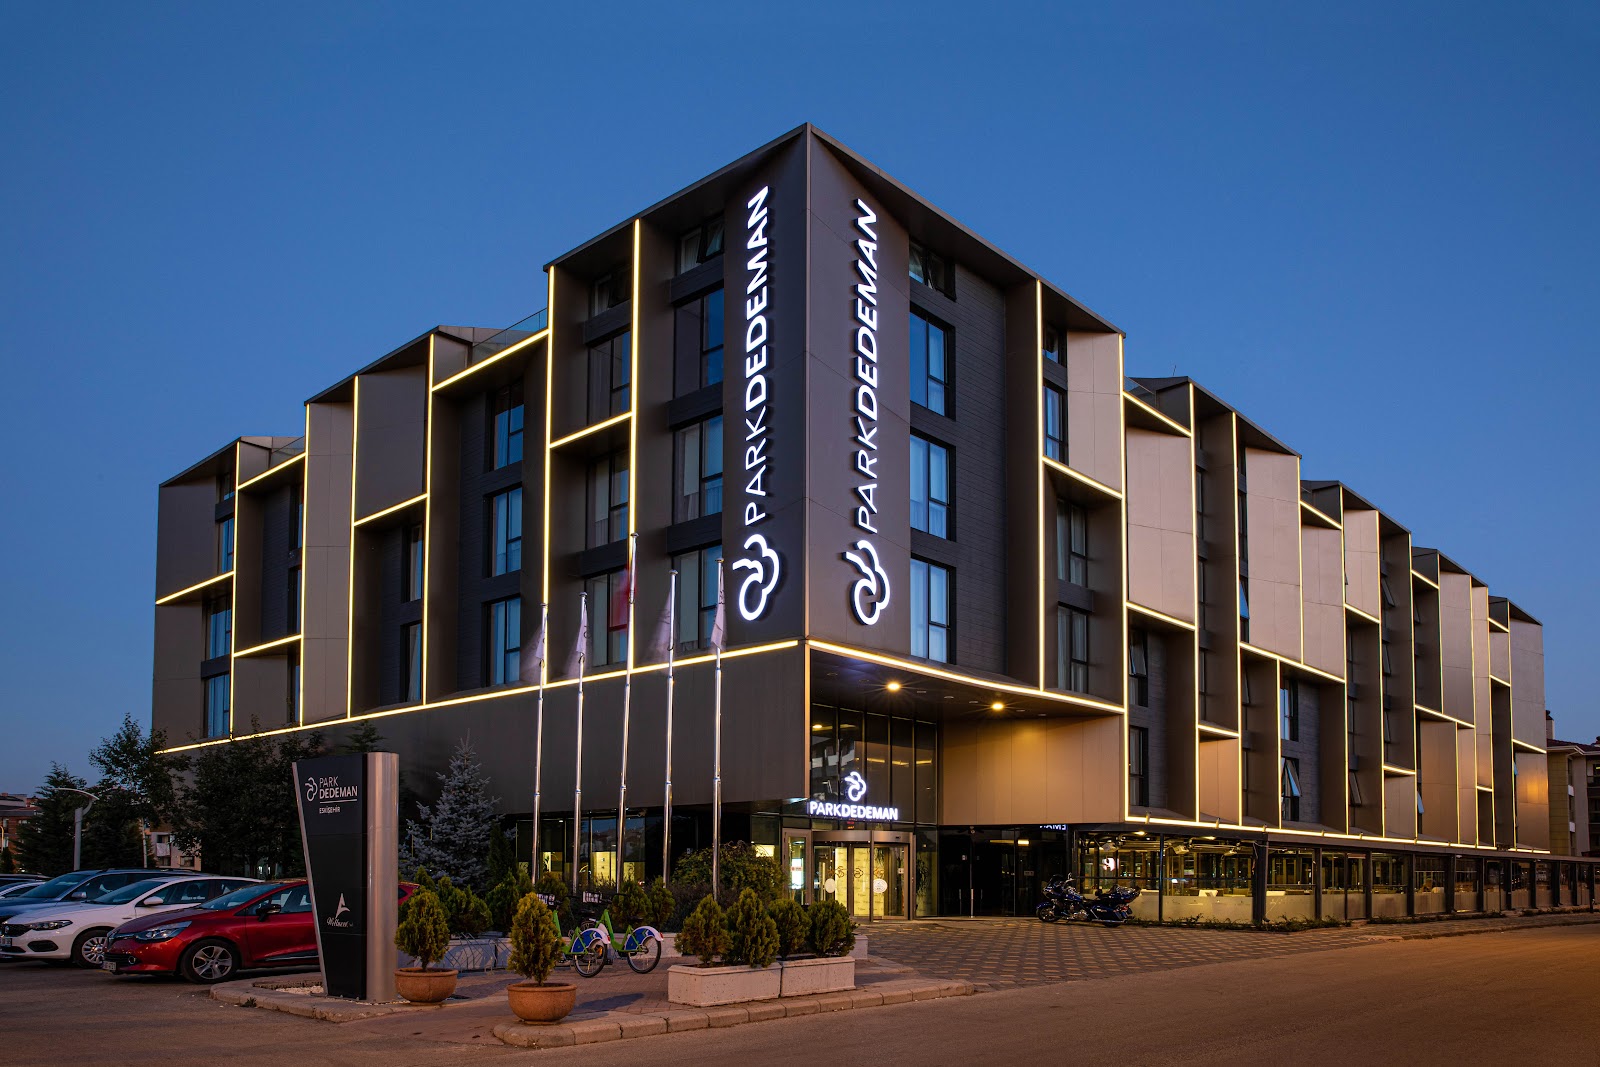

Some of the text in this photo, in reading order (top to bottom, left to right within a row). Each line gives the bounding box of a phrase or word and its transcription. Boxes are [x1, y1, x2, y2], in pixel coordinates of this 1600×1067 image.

[744, 185, 769, 526] PARKDEDEMAN
[856, 198, 878, 534] PARKDEDEMAN
[319, 776, 339, 788] PARK
[319, 785, 358, 800] DEDEMAN
[809, 800, 899, 821] PARKDEDEMAN
